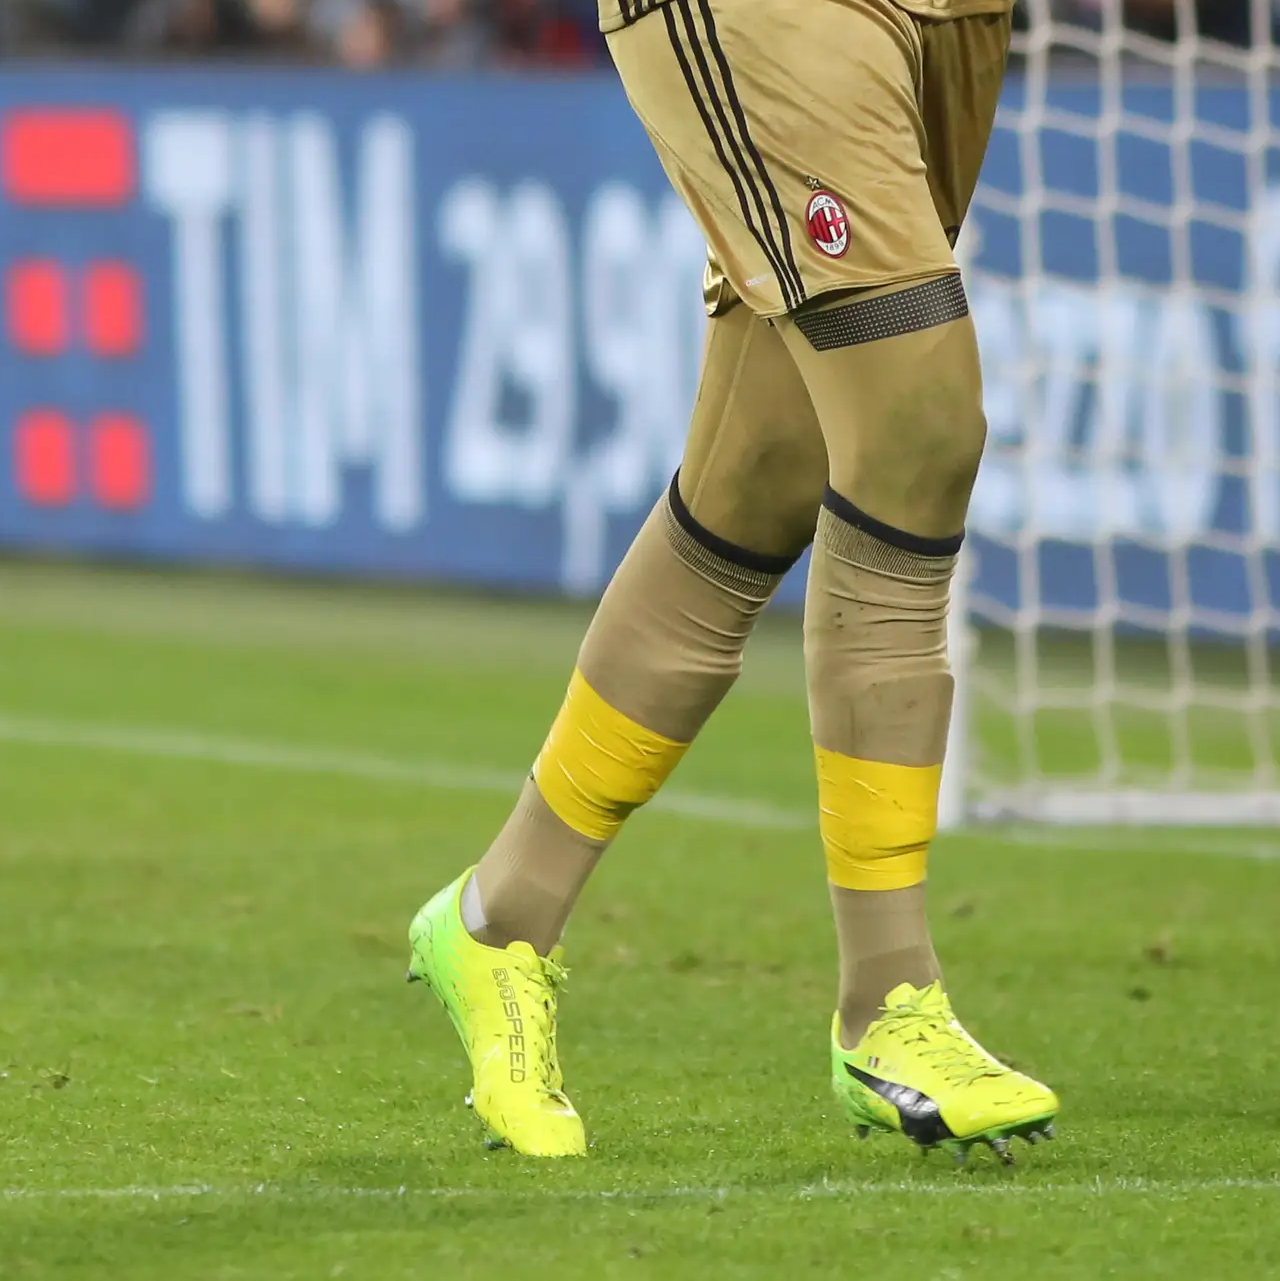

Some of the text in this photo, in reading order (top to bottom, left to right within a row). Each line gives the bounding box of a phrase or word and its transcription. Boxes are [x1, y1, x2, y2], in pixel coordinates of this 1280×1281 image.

[812, 197, 835, 210] ACM
[825, 240, 845, 252] 1899
[144, 105, 426, 535] TIM
[964, 281, 1222, 551] ezzo
